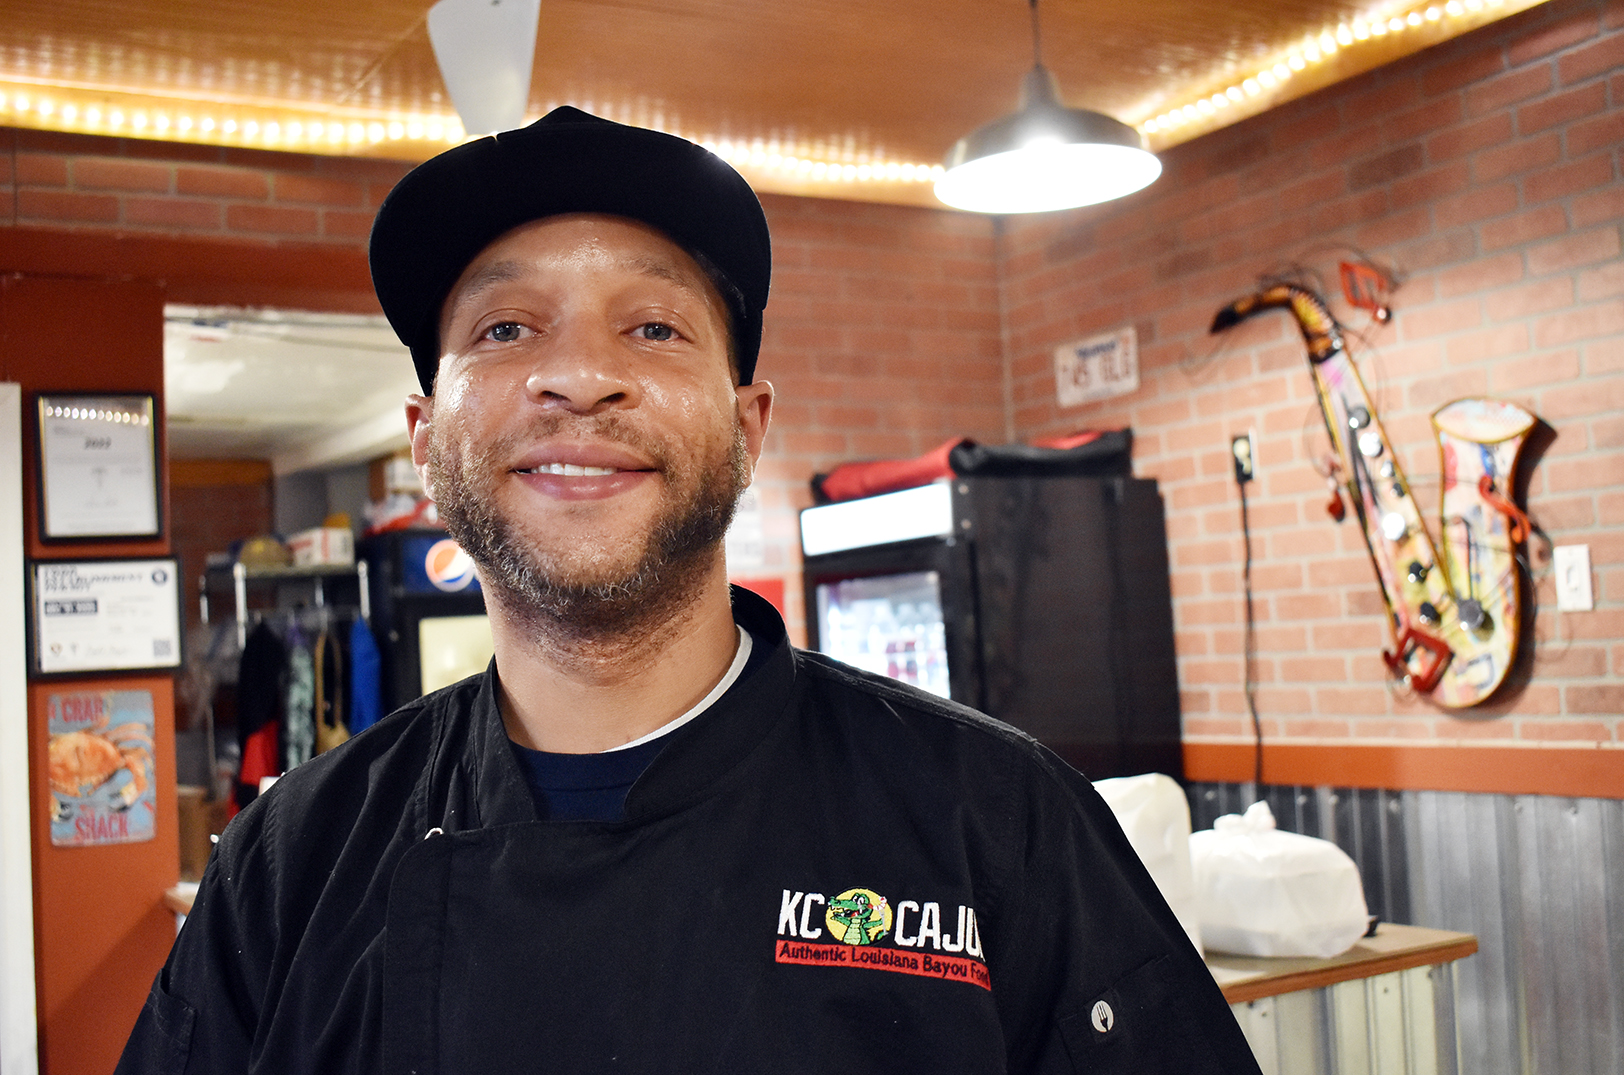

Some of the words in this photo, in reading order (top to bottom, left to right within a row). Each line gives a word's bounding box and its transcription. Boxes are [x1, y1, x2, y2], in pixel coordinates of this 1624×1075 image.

[75, 814, 128, 840] SHACK
[777, 889, 825, 939] KC
[894, 900, 986, 962] CAJU
[779, 942, 846, 962] Authentic
[852, 946, 918, 970] Louisiana
[923, 956, 967, 978] Bayou
